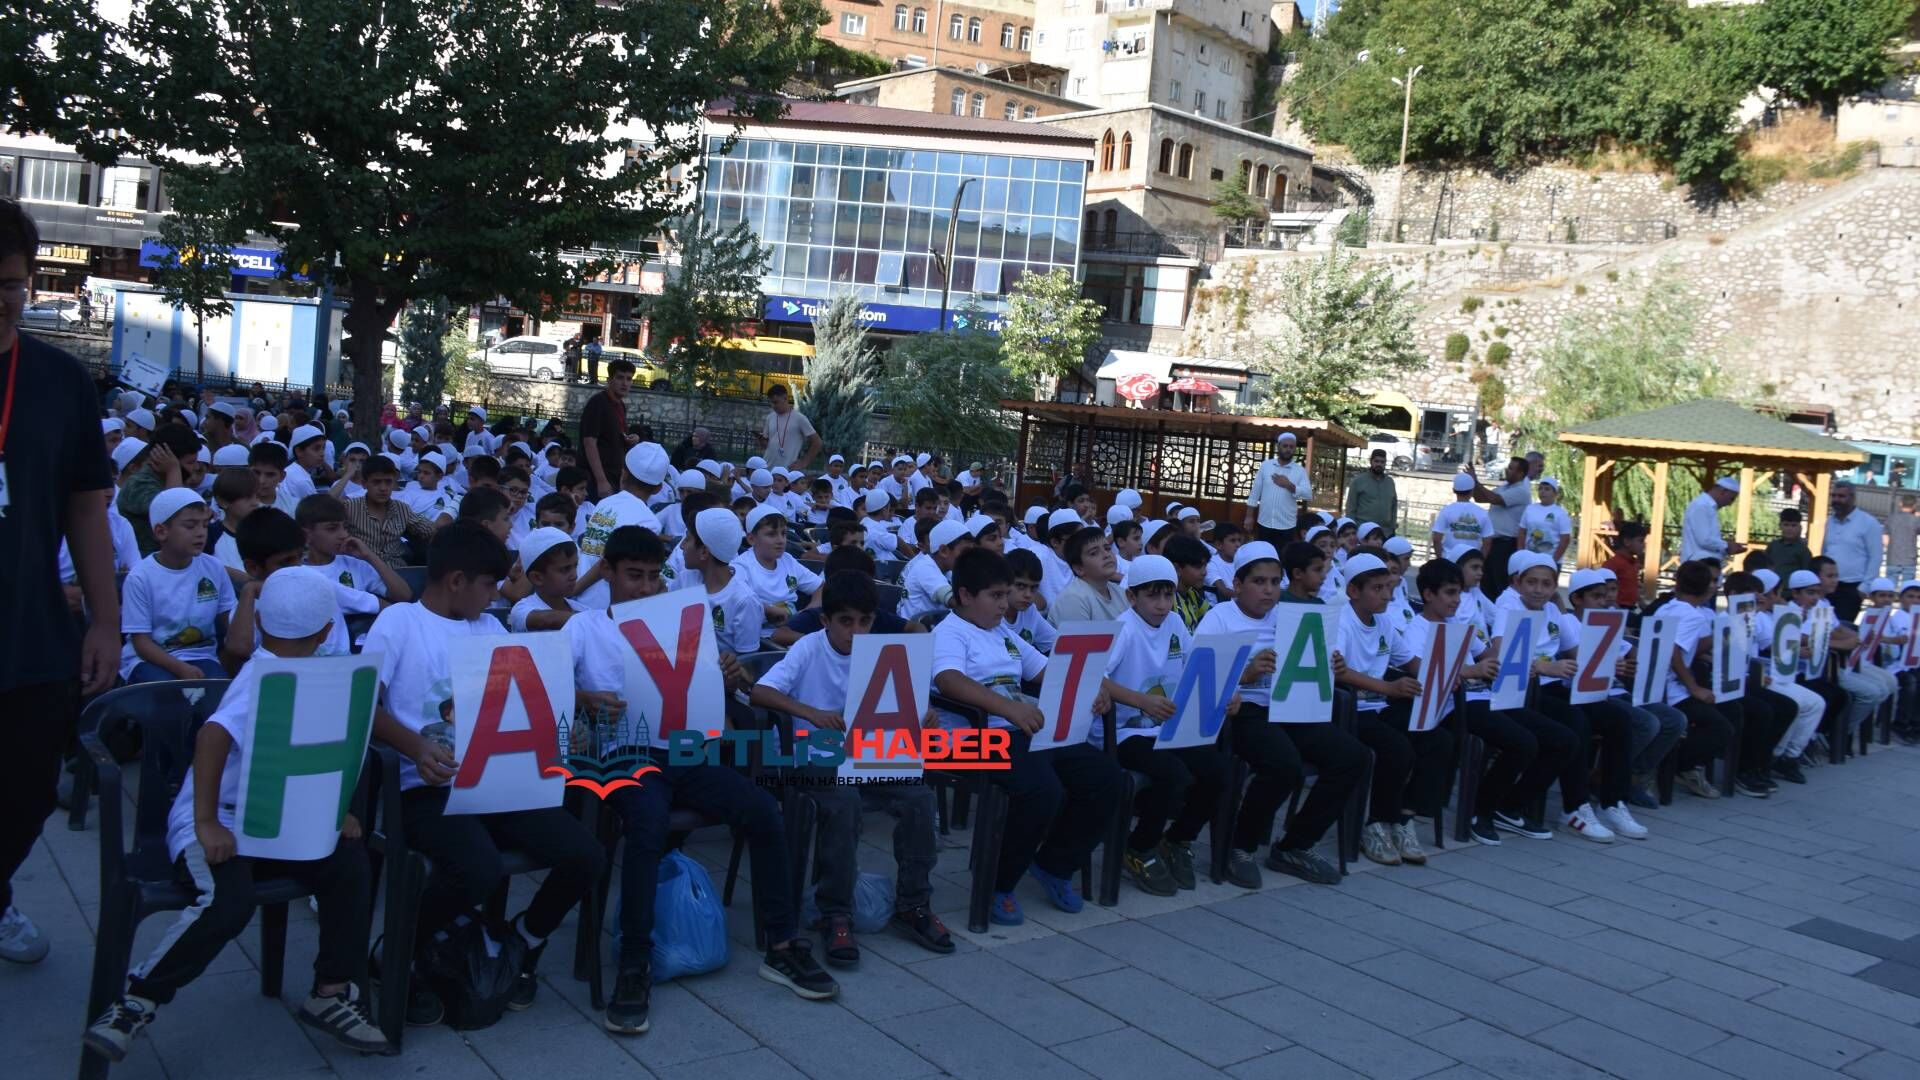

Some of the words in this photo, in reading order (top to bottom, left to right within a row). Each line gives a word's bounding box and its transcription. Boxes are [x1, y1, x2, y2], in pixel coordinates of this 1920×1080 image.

[242, 665, 379, 839] H
[453, 645, 560, 789] A
[618, 603, 705, 740] Y
[844, 643, 922, 756] A
[1053, 633, 1114, 742] T
[1159, 645, 1253, 742] N
[1271, 612, 1333, 702] A
[1492, 617, 1532, 693] A
[1577, 612, 1624, 692] Z
[1721, 626, 1741, 694] L
[1774, 613, 1801, 676] G
